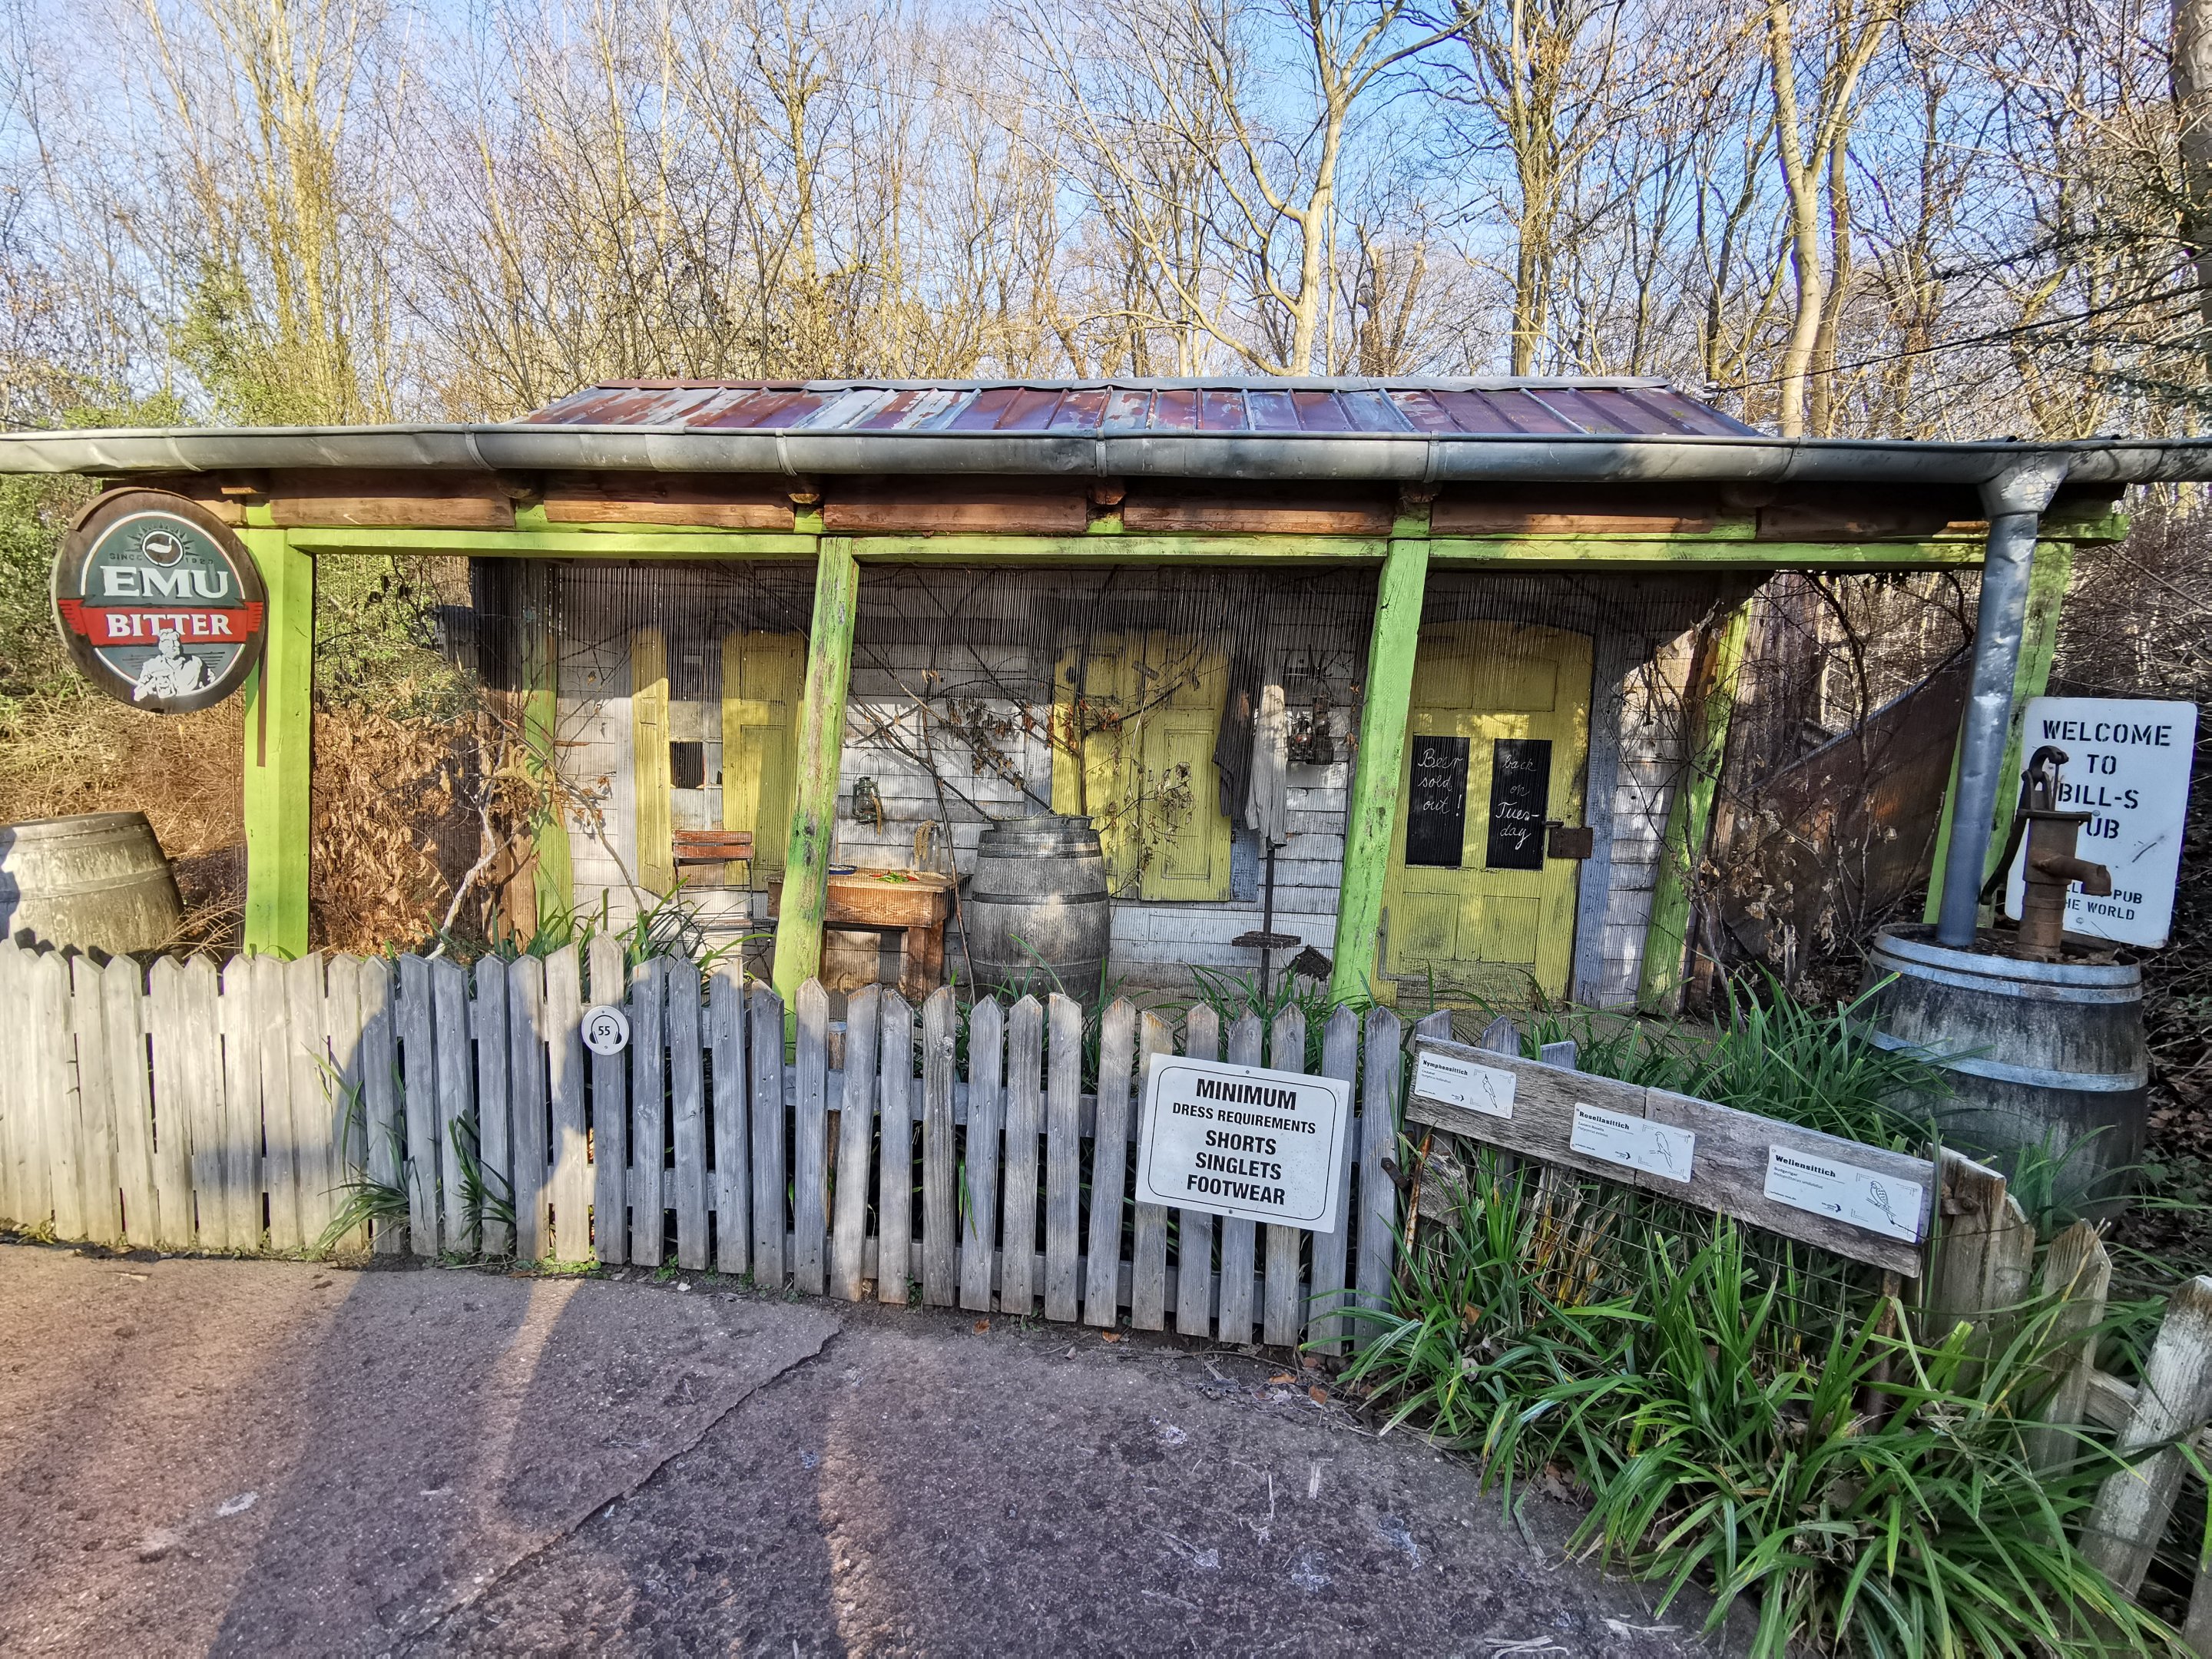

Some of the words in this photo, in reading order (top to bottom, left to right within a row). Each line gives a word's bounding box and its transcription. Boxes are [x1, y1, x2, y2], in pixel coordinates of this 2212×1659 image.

[100, 565, 229, 599] EMU
[105, 614, 233, 637] BITTER
[2043, 720, 2172, 747] WELCOME
[1418, 748, 1463, 768] Beer
[1502, 754, 1537, 772] back
[2087, 753, 2117, 775] TO
[1418, 775, 1453, 792] sold
[1510, 783, 1531, 796] on
[2058, 783, 2140, 810] BILL-S
[1500, 823, 1532, 850] day
[2086, 818, 2120, 839] UB
[2113, 889, 2143, 904] PUB
[2087, 901, 2135, 920] WORLD
[598, 1025, 611, 1036] 55
[1422, 1059, 1469, 1076] Nymphensittich
[1196, 1078, 1297, 1111] MINIMUM
[1173, 1102, 1214, 1119] DRESS
[1217, 1110, 1316, 1134] REQUIREMENTS
[1579, 1111, 1630, 1130] Rosellasittich
[1205, 1130, 1277, 1155] SHORTS
[1195, 1152, 1282, 1181] SINGLETS
[1775, 1154, 1836, 1177] Wellensittich
[1187, 1174, 1285, 1205] FOOTWEAR
